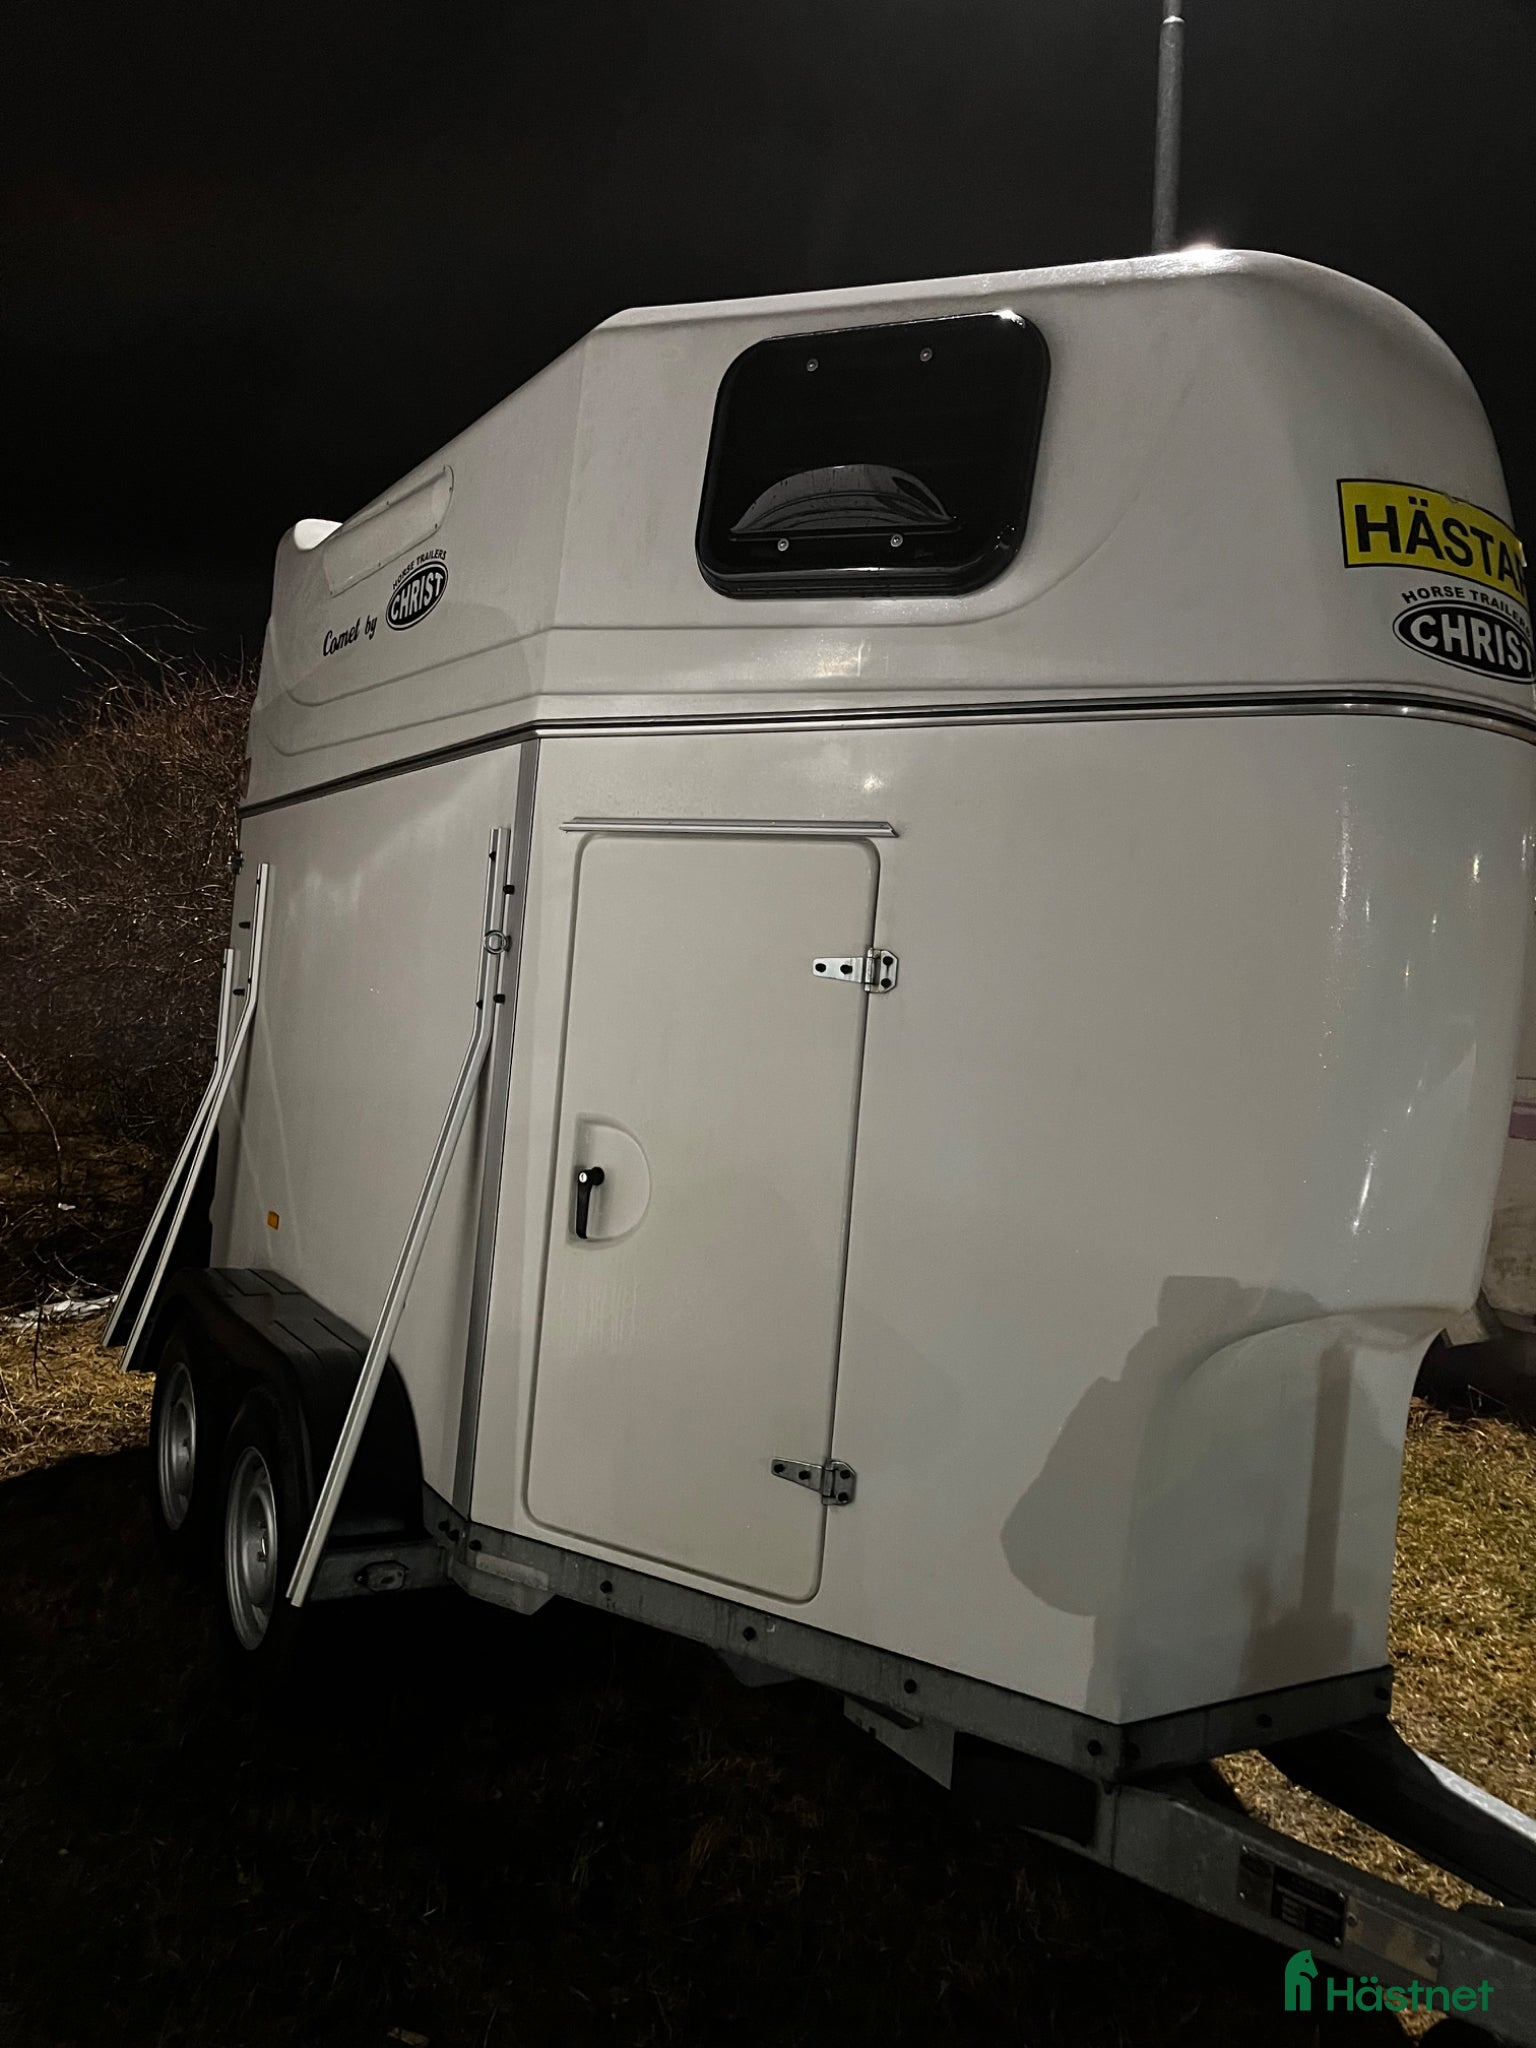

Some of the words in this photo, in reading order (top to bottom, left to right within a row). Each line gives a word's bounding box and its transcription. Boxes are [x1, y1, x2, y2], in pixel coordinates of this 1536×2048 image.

[392, 561, 415, 590] HORSE
[416, 549, 447, 566] TRAILERS
[391, 572, 444, 621] CHRIST
[1401, 586, 1465, 604] HORSE
[364, 614, 378, 640] by
[1410, 613, 1533, 673] CHRIST
